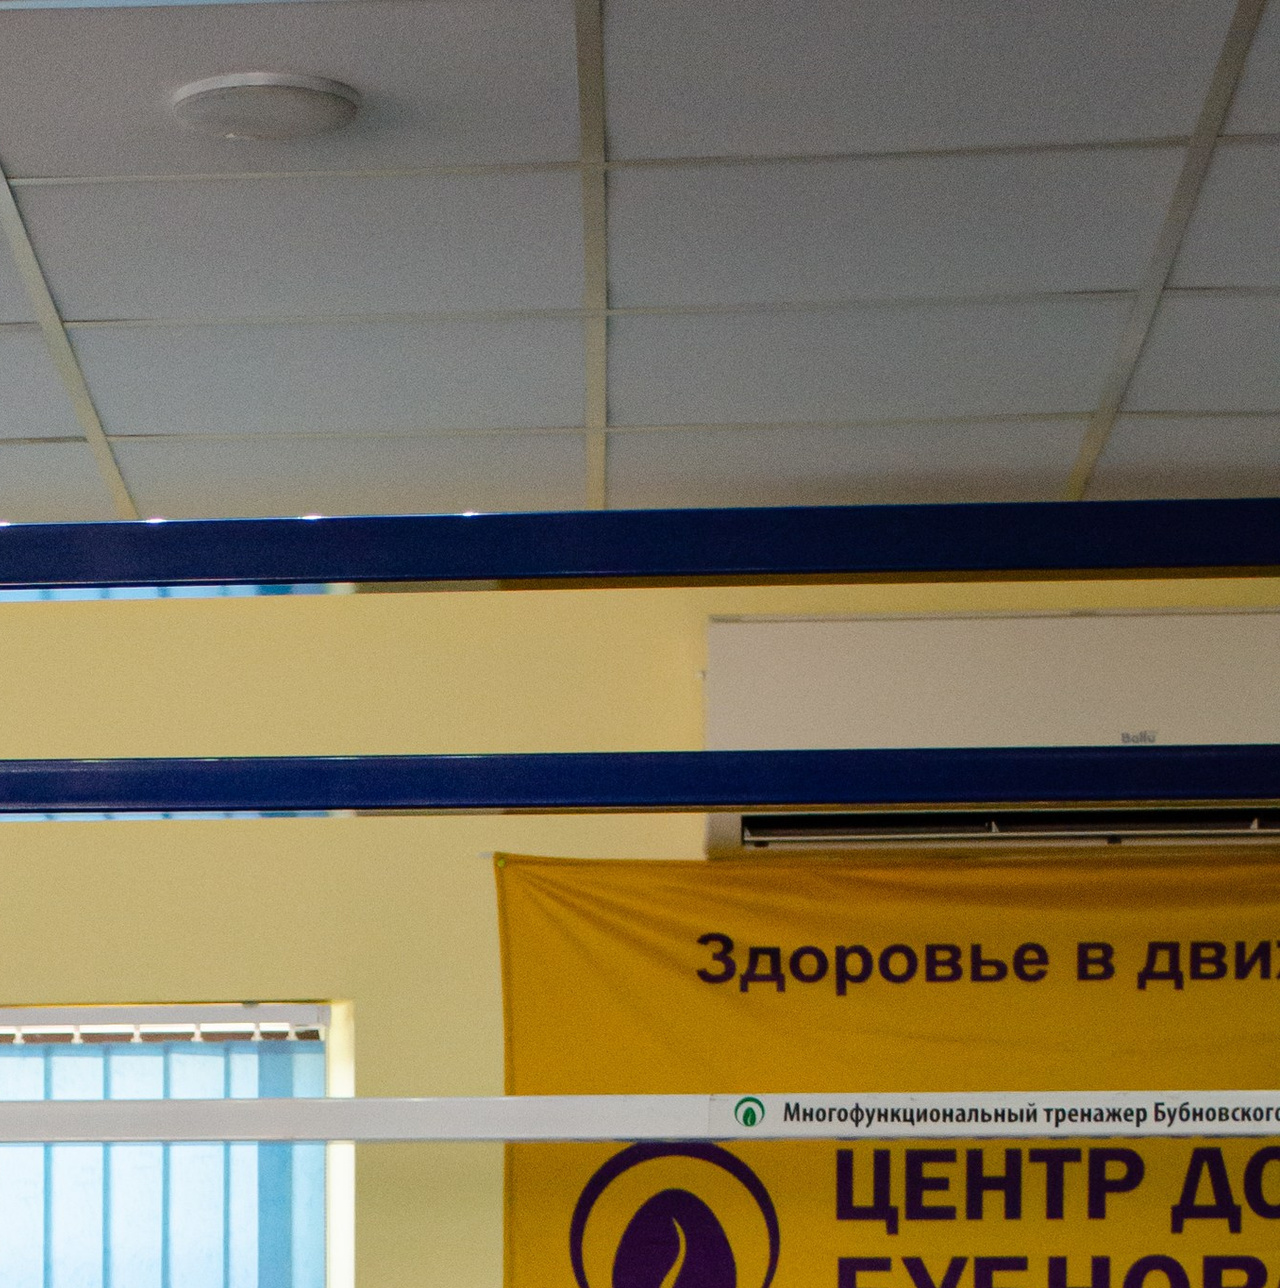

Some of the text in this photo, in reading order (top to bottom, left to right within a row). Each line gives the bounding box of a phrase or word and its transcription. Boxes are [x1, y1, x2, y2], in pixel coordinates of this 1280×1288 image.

[696, 933, 1280, 995] Здоровье в дви
[783, 1102, 1037, 1128] Многофункциональный
[1044, 1107, 1148, 1128] тренажер
[836, 1147, 1146, 1236] ЦЕНТР
